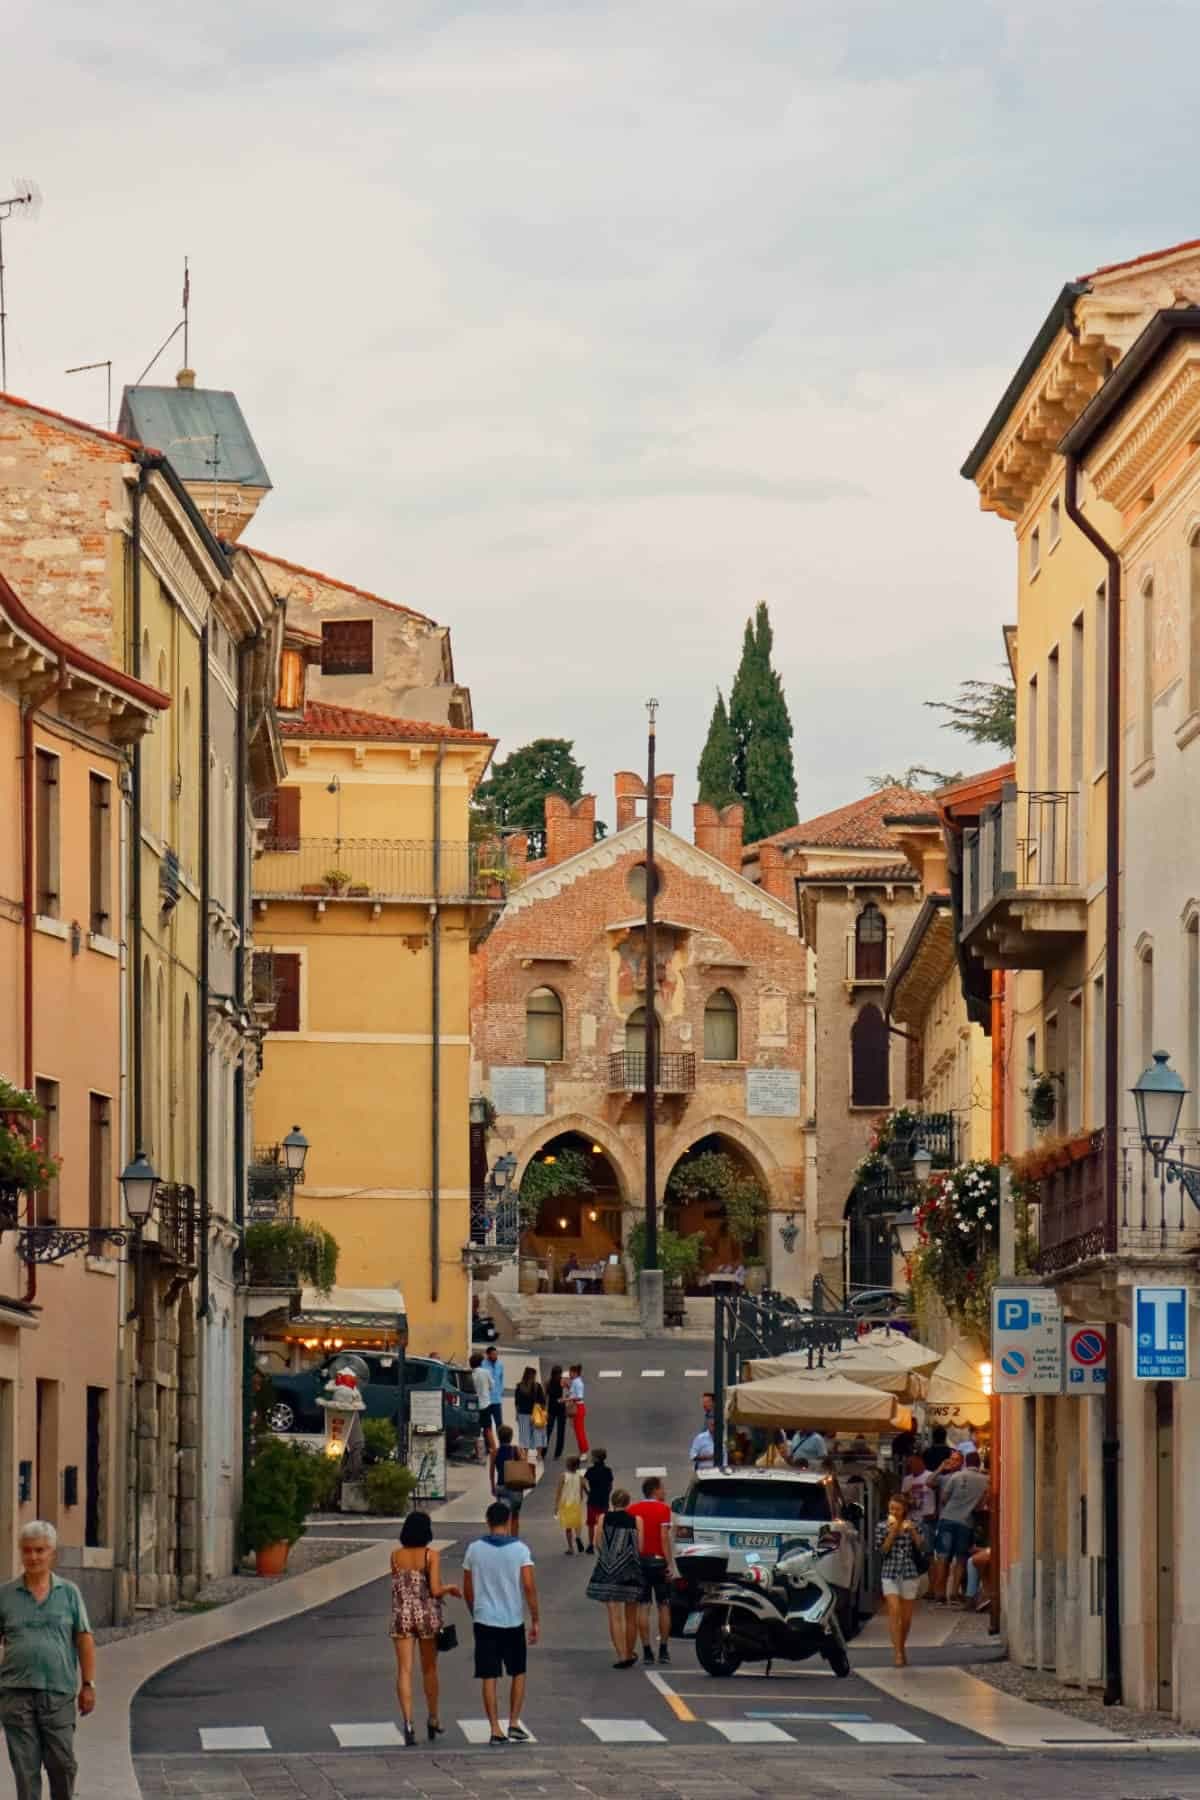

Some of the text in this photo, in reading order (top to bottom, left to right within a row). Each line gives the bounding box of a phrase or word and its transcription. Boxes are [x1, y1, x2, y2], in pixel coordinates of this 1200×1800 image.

[1005, 1303, 1022, 1326] P
[1140, 1290, 1182, 1350] T
[1073, 1370, 1082, 1380] P
